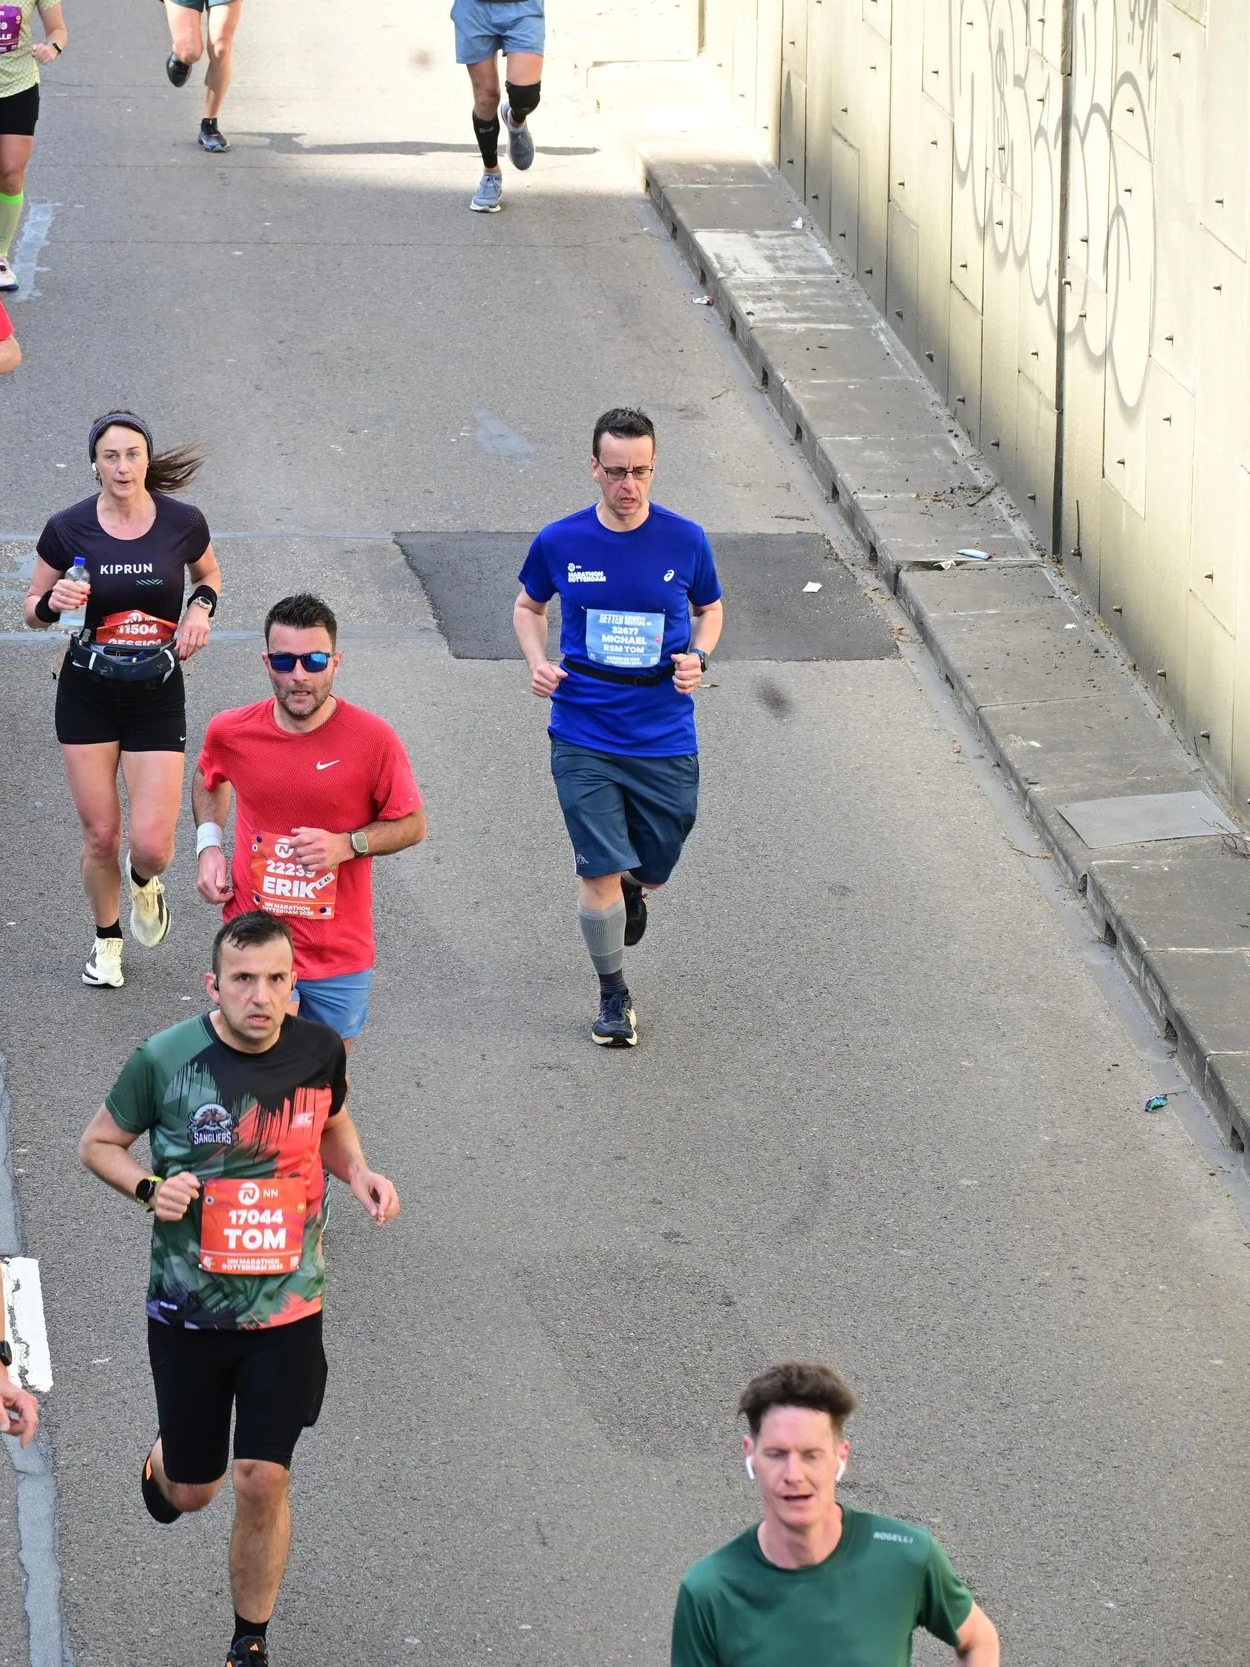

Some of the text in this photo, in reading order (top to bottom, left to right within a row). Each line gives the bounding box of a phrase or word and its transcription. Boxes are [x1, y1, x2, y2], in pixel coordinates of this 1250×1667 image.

[100, 563, 153, 575] KIPRUN
[118, 623, 158, 635] 11504
[612, 626, 639, 635] 32677
[601, 634, 648, 645] MICHAEL
[263, 875, 317, 899] ERIK
[262, 905, 299, 915] TTERDAM
[273, 903, 311, 911] MARATHON
[193, 1132, 232, 1145] SANGLIERS
[263, 1189, 279, 1198] NN
[228, 1208, 284, 1225] 17044
[223, 1228, 287, 1250] TOM
[873, 1531, 914, 1545] ROGELLI
